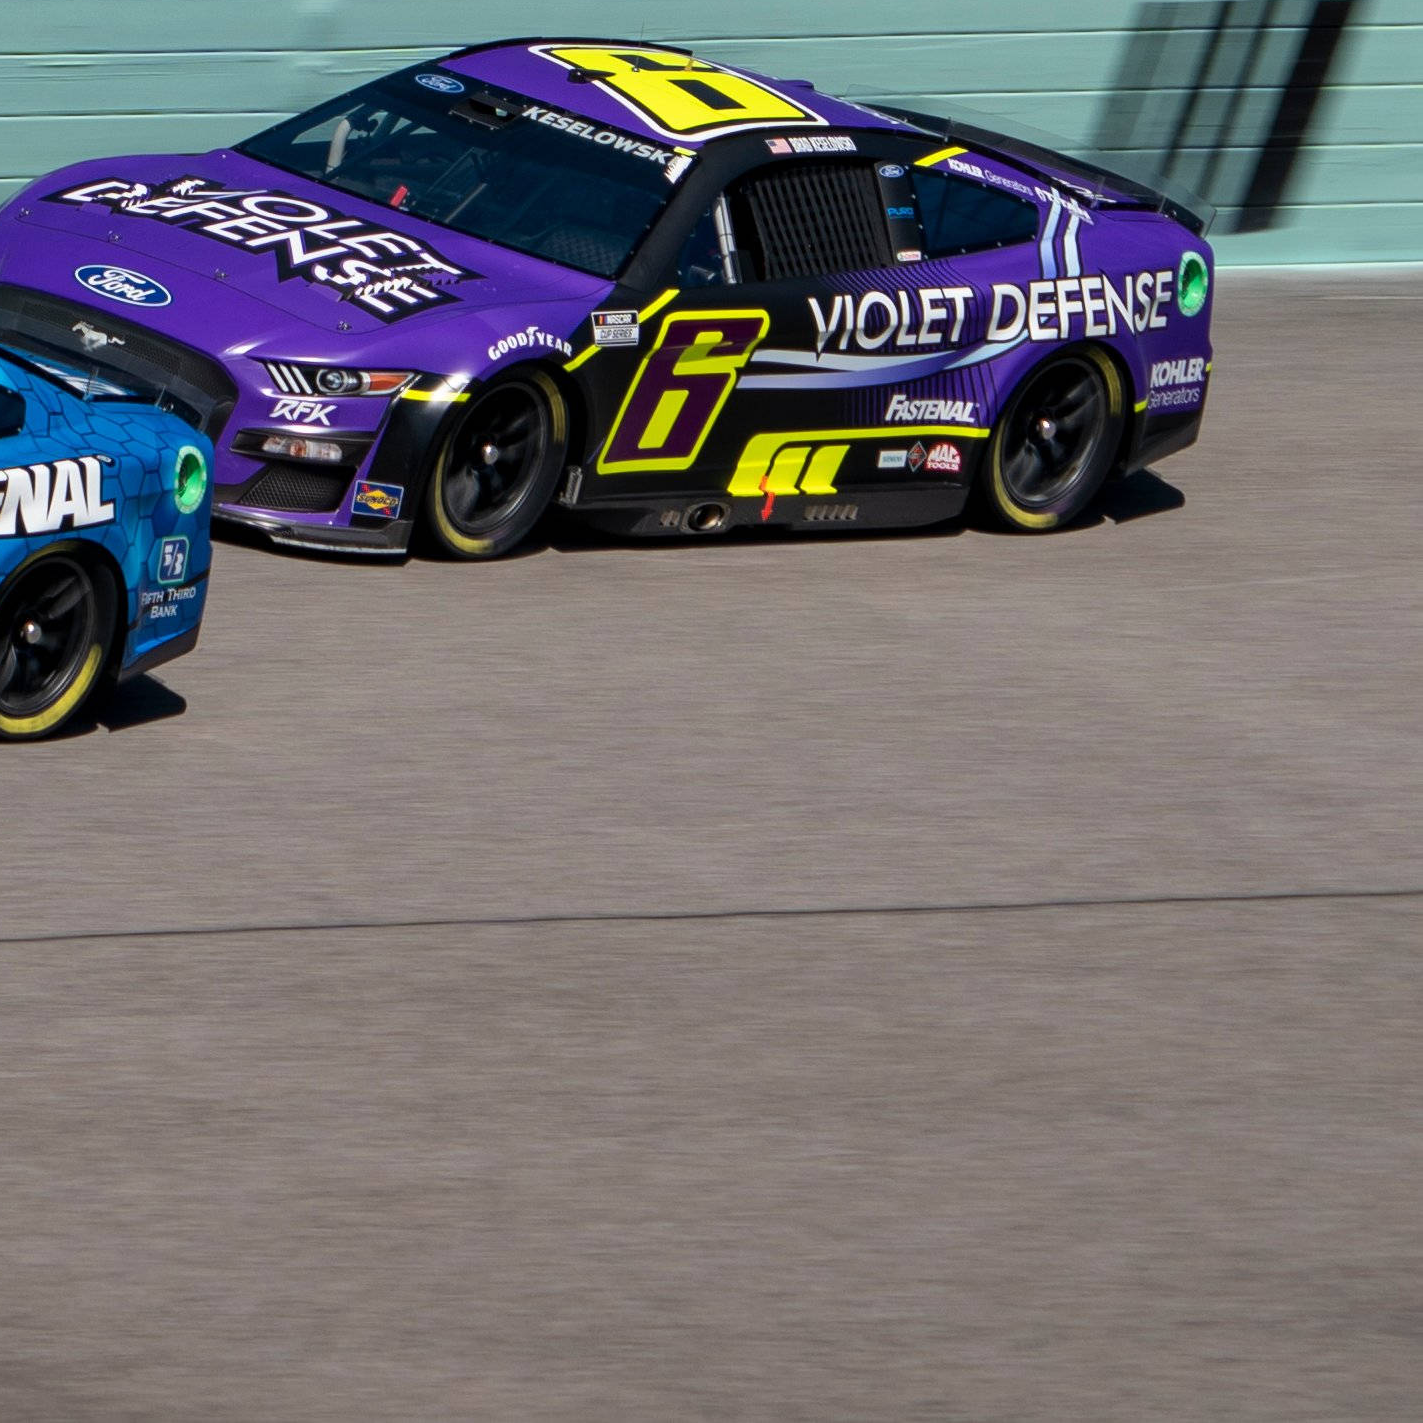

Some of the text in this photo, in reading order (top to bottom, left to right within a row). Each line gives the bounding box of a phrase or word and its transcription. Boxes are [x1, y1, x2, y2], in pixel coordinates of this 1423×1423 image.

[528, 44, 830, 141] 6
[947, 158, 986, 179] KOHLER
[985, 169, 1034, 197] Generators
[86, 268, 158, 301] Ford
[607, 314, 632, 325] NASCAR
[807, 271, 1173, 361] VIOLET DEFENSE
[488, 326, 573, 361] GOODYEAR
[600, 328, 633, 339] CUP SERIES
[1150, 358, 1205, 388] KOHLER
[597, 309, 770, 475] 6
[1147, 386, 1201, 410] Generators
[269, 399, 338, 426] RFK
[885, 394, 975, 423] FASTENAL
[928, 444, 961, 463] MAC
[929, 461, 959, 472] TOOLS
[356, 492, 400, 508] SUNOCO
[167, 586, 197, 601] THIRD
[150, 604, 178, 619] BANK
